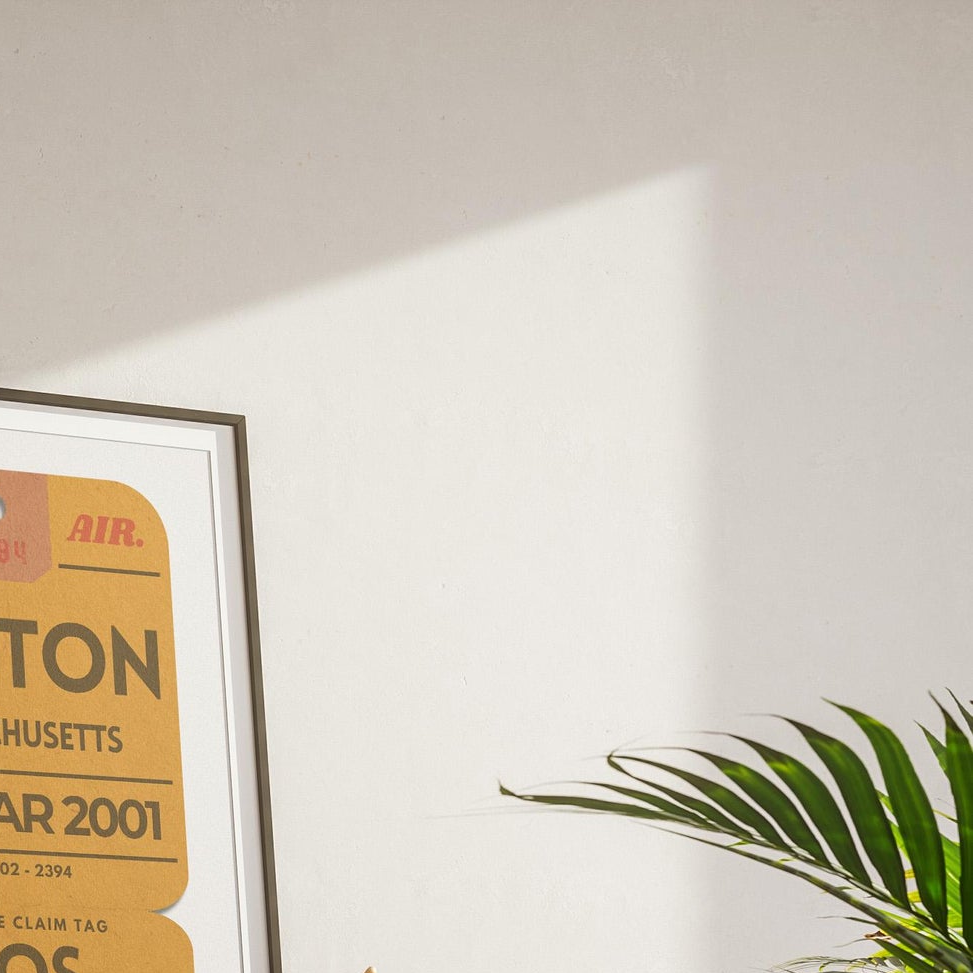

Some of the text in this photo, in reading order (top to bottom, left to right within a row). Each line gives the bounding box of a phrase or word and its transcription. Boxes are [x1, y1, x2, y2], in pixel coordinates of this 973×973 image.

[66, 514, 144, 547] AIR.
[63, 795, 162, 841] 2001
[34, 863, 73, 879] 2394
[12, 915, 67, 932] CLAIM
[73, 918, 109, 934] TAG
